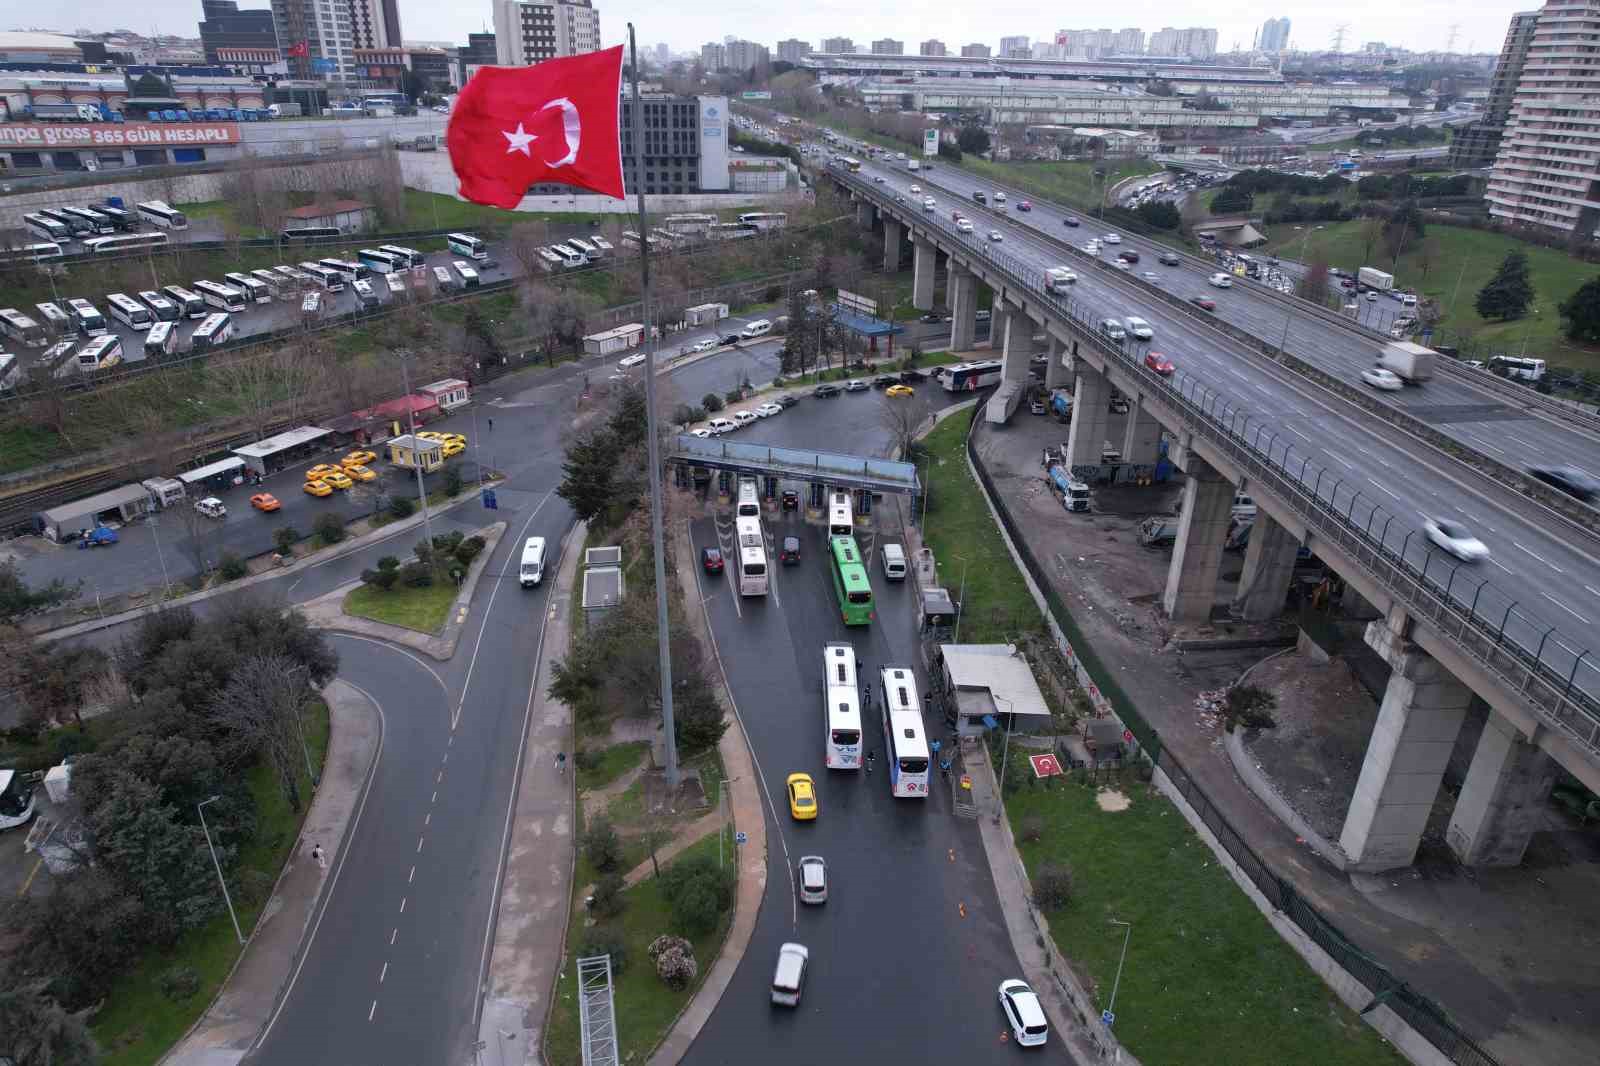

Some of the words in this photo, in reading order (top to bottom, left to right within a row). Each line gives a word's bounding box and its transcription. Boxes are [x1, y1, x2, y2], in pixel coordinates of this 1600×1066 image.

[43, 128, 90, 144] gross
[94, 130, 124, 143] 365
[126, 126, 160, 142] GÜN
[164, 128, 229, 141] HESAPLI
